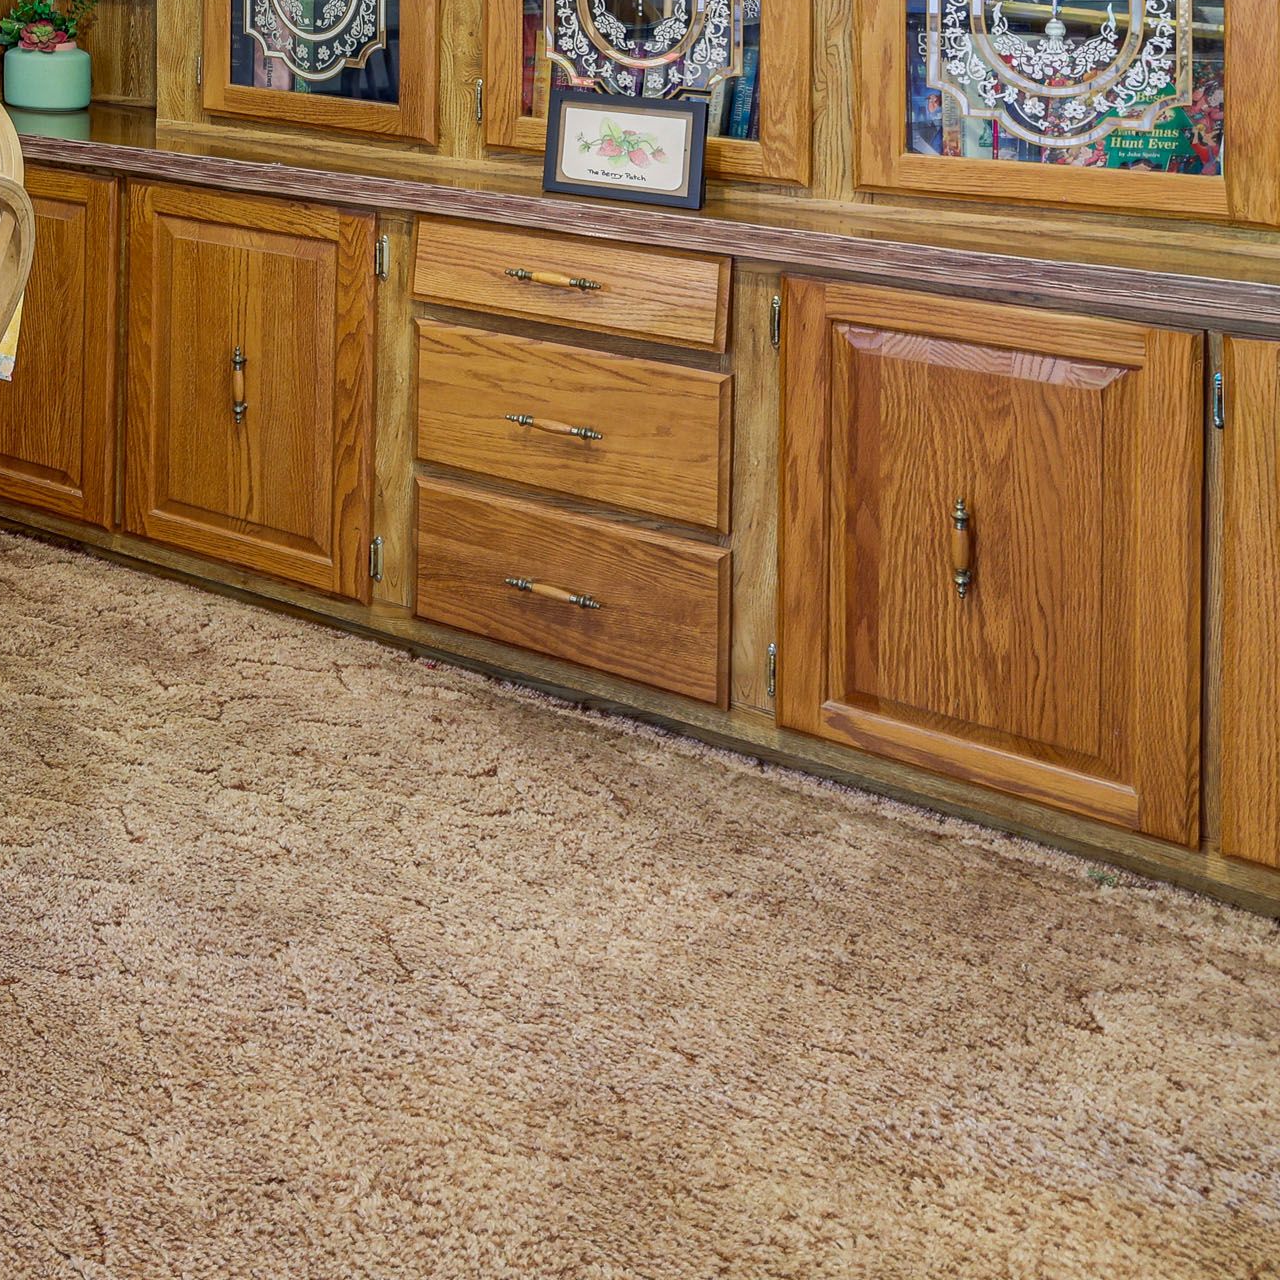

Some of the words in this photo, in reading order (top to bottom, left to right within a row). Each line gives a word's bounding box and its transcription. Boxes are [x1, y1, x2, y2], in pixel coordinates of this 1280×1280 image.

[1110, 137, 1145, 149] Hunt
[1148, 138, 1179, 150] Ever
[587, 168, 599, 176] The
[600, 170, 623, 180] Berry
[625, 172, 647, 182] Patch
